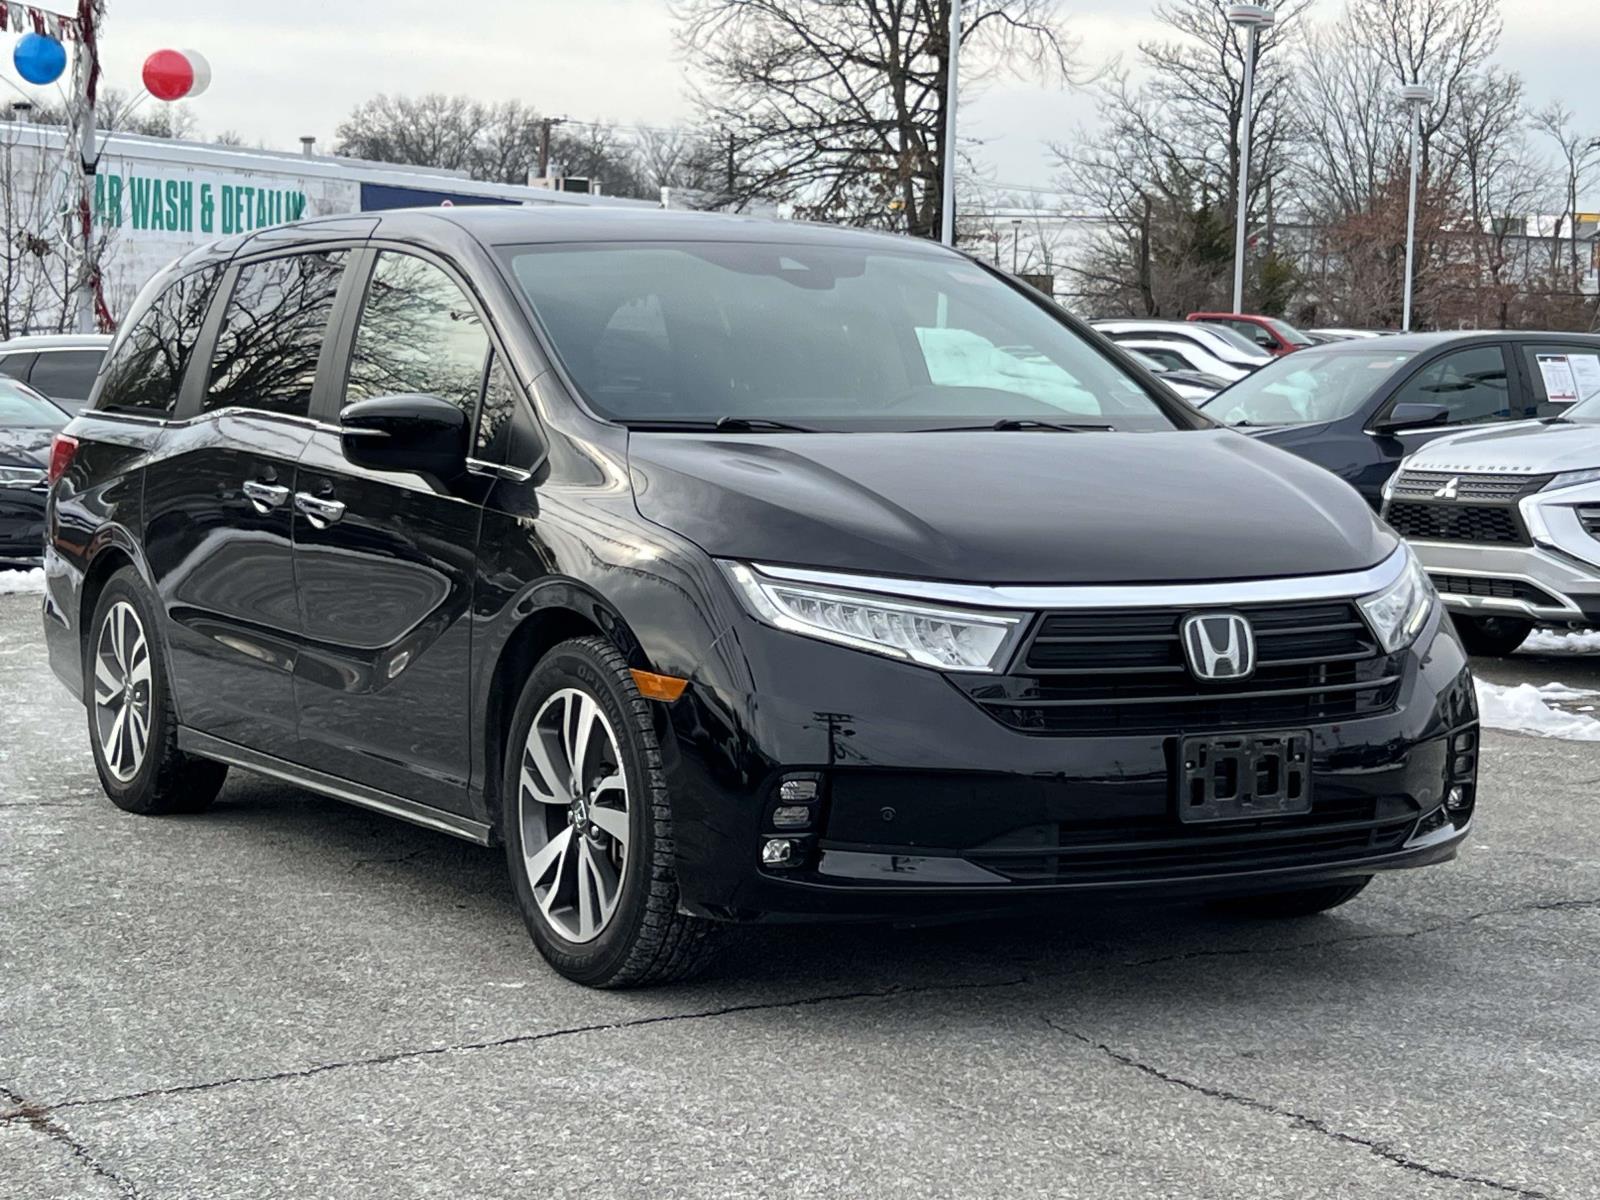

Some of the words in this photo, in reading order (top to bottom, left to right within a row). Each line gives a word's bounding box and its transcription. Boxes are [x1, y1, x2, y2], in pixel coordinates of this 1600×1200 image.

[93, 173, 122, 228] AR
[129, 177, 193, 232] WASH
[201, 184, 214, 233] &
[222, 185, 305, 234] DETAILIN
